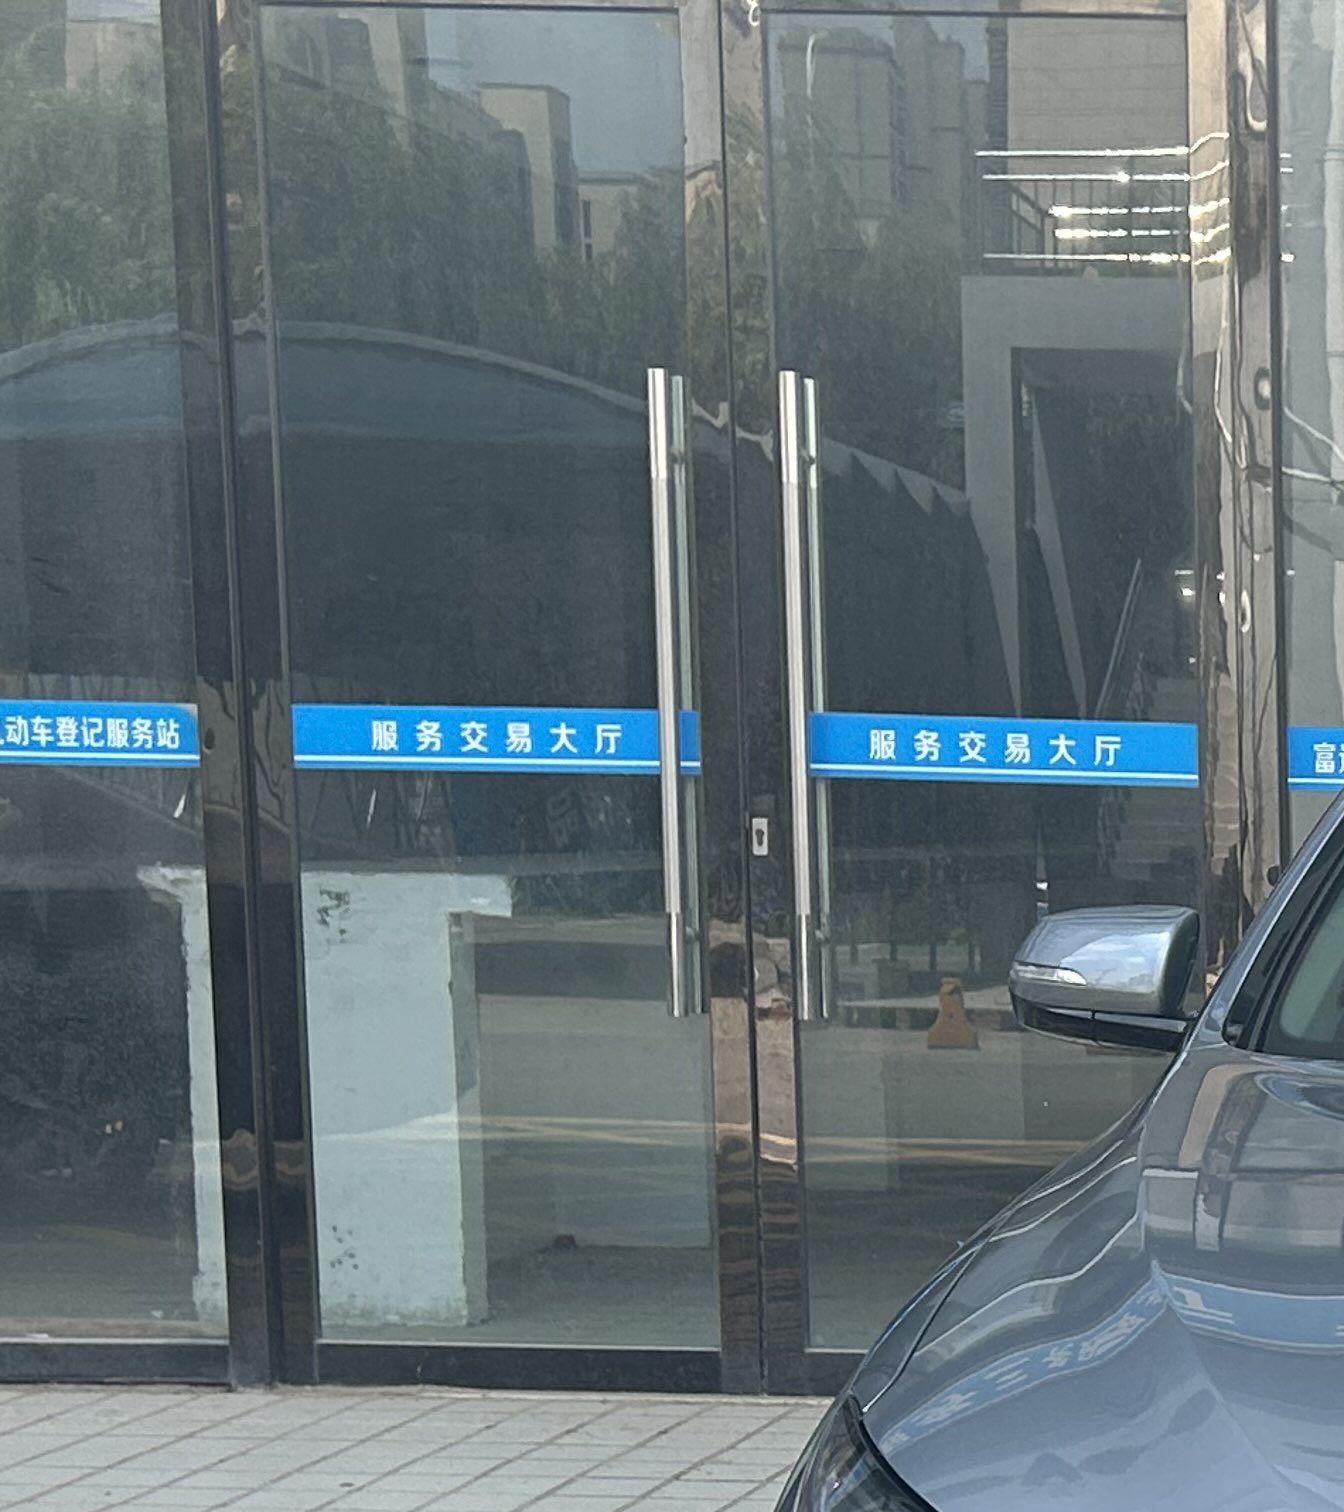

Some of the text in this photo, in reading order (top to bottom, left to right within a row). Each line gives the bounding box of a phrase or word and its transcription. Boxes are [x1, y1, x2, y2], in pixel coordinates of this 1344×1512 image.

[0, 706, 180, 749] 动车登记服务站
[371, 720, 622, 754] 服务交易大厅
[868, 728, 1122, 766] 服务交易大厅
